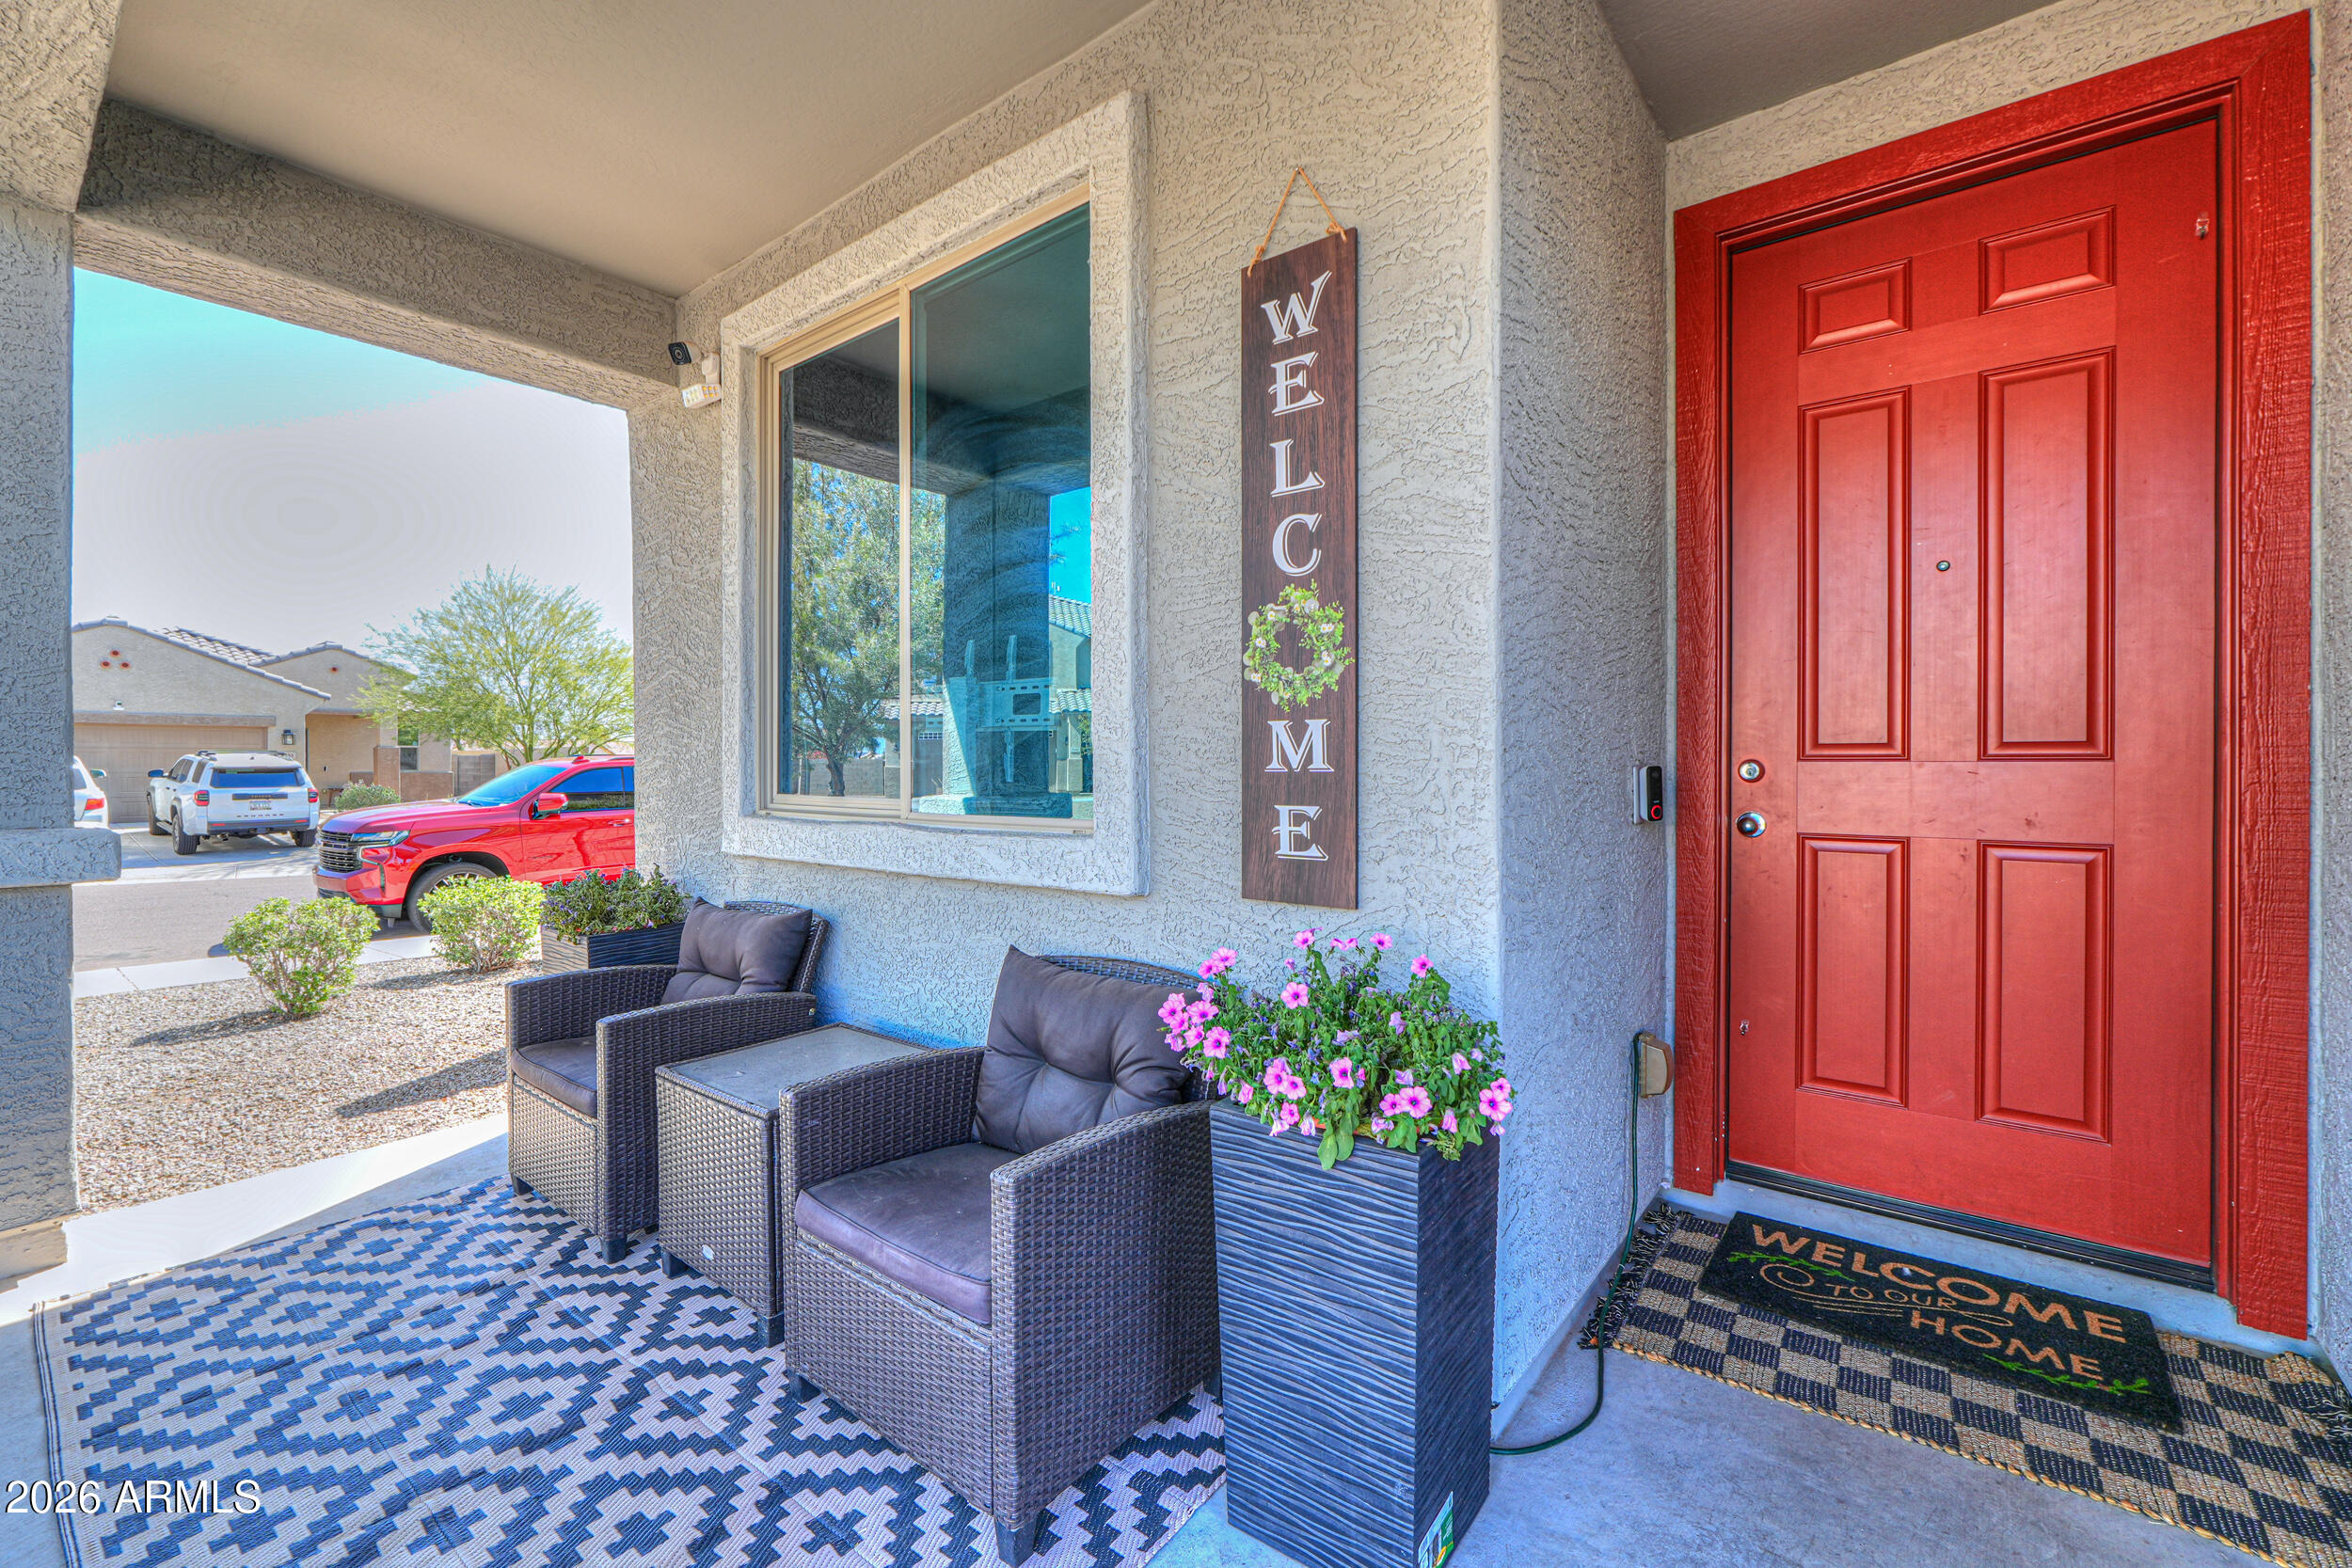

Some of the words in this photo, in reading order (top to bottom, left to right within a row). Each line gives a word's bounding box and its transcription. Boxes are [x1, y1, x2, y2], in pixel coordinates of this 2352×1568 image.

[1751, 1224, 2126, 1343] WELCOME
[1826, 1284, 1875, 1301] TO
[1883, 1289, 1958, 1310] OUR
[1910, 1311, 2104, 1381] HOME
